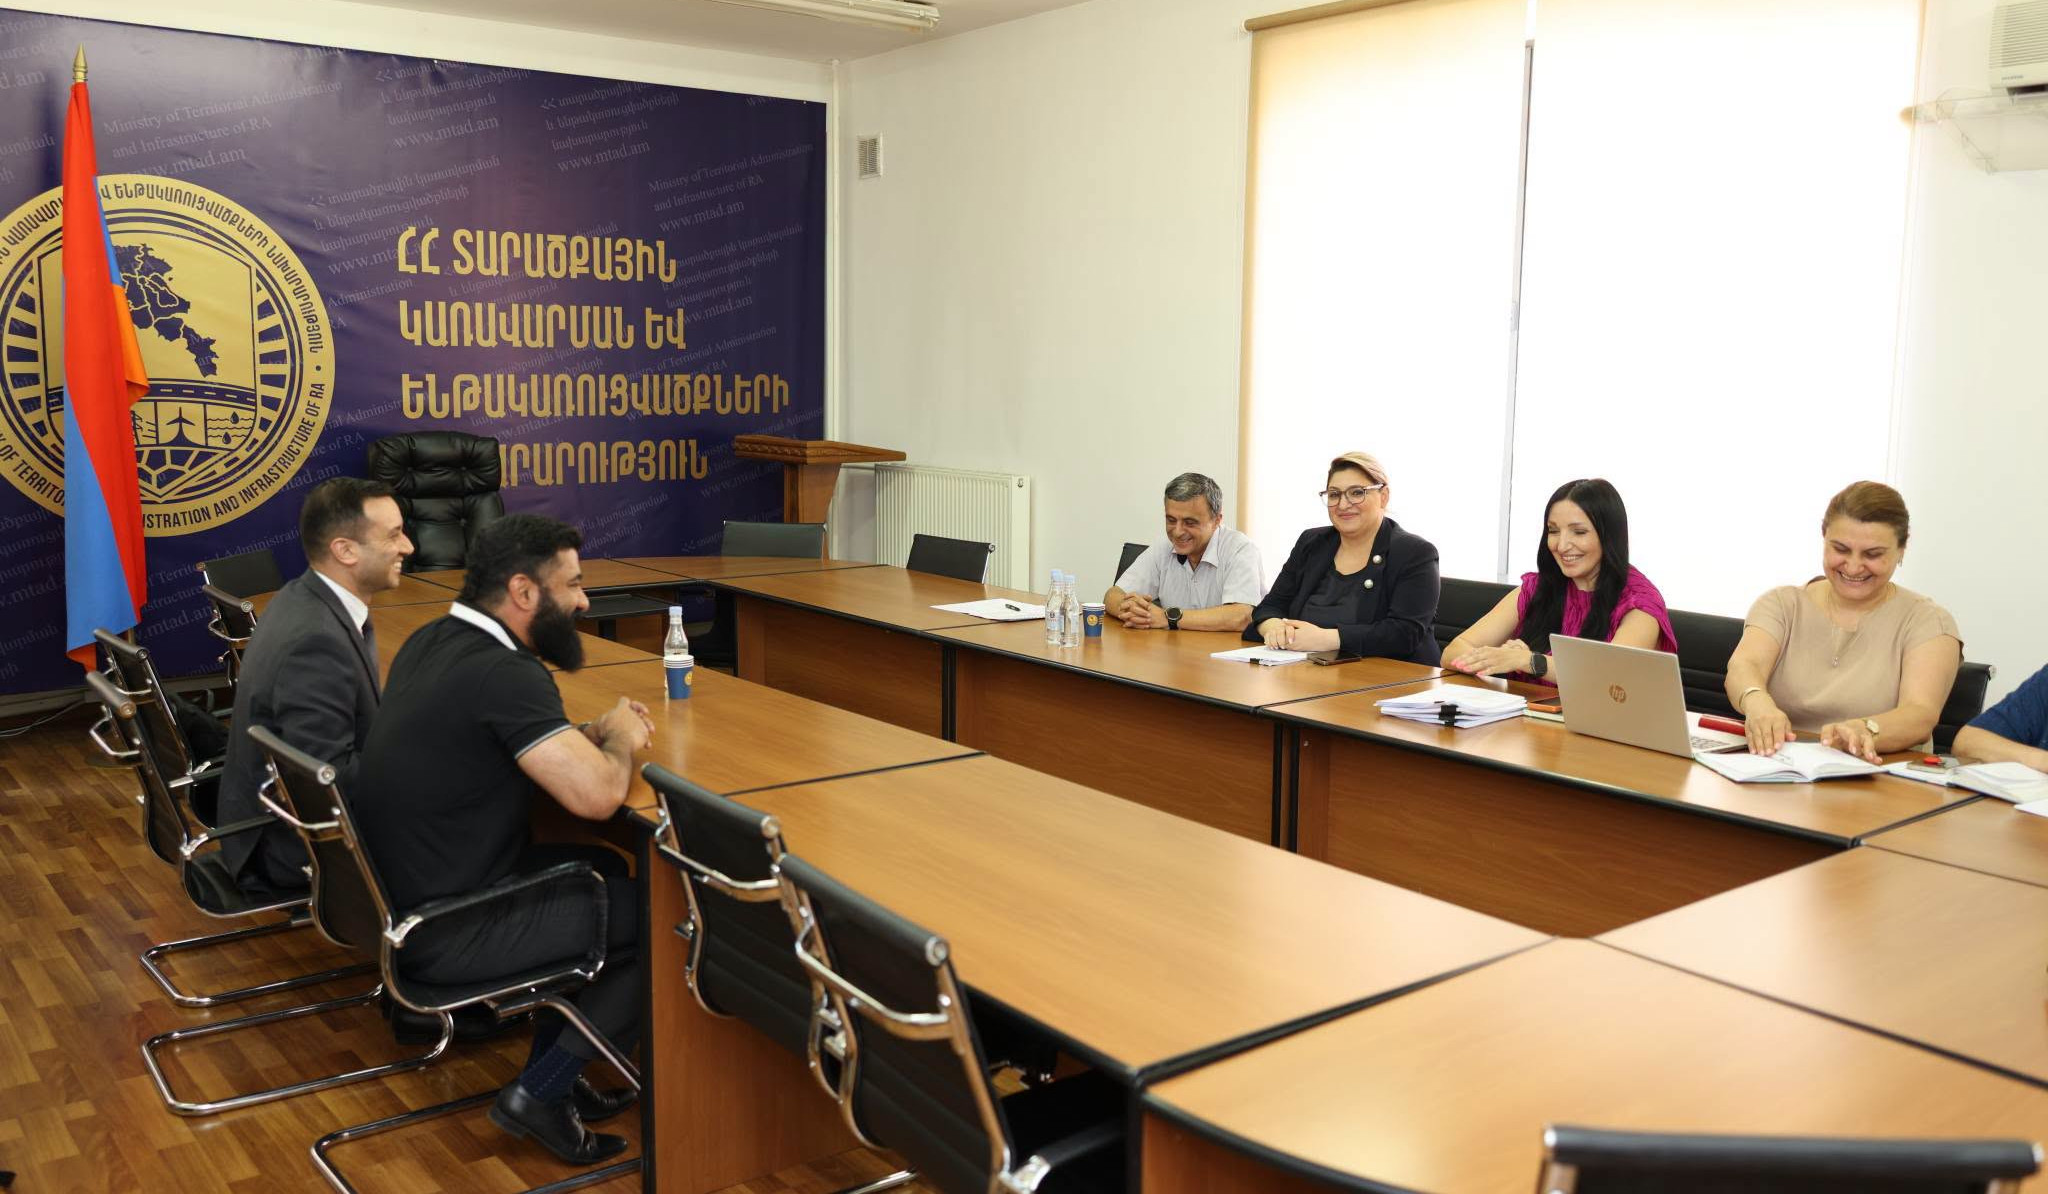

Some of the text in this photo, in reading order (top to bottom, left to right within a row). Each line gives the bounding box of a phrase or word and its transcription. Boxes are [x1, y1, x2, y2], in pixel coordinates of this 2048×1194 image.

[104, 80, 343, 136] Ministry of Territorial Administration
[112, 115, 272, 159] and Infrastructure of RA
[392, 116, 499, 149] www.mtad.am
[557, 141, 650, 172] www.mtad.am
[648, 175, 689, 194] Ministry
[702, 159, 747, 179] Territorial
[653, 200, 672, 212] and
[747, 174, 764, 187] RA
[2, 197, 63, 246] ԿԱՌԱՎԱՐ
[658, 201, 745, 233] www.mtad.am
[398, 226, 441, 275] ՀՀ
[452, 228, 677, 283] ՏԱՐԱԾՔԱՅԻՆ
[328, 278, 413, 308] Administration
[399, 300, 687, 350] ԿԱՌԱՎԱՐՄԱՆ ԵՎ
[309, 383, 325, 399] RA
[401, 373, 789, 420] ԵՆԹԱԿԱՌՈՒՑՎԱԾՔՆԵՐԻ
[305, 400, 321, 417] OF
[343, 432, 365, 447] RA
[238, 417, 316, 504] INFRASTRUCTURE
[499, 438, 709, 489] ՐԱՐՈՒԹՅՈՒՆ
[13, 459, 64, 506] TERRITO
[283, 463, 342, 492] tad.am
[142, 506, 212, 529] ISTRATION
[213, 495, 240, 518] AND
[224, 527, 302, 558] Administrati
[144, 585, 203, 611] structure
[1609, 682, 1626, 703] hp
